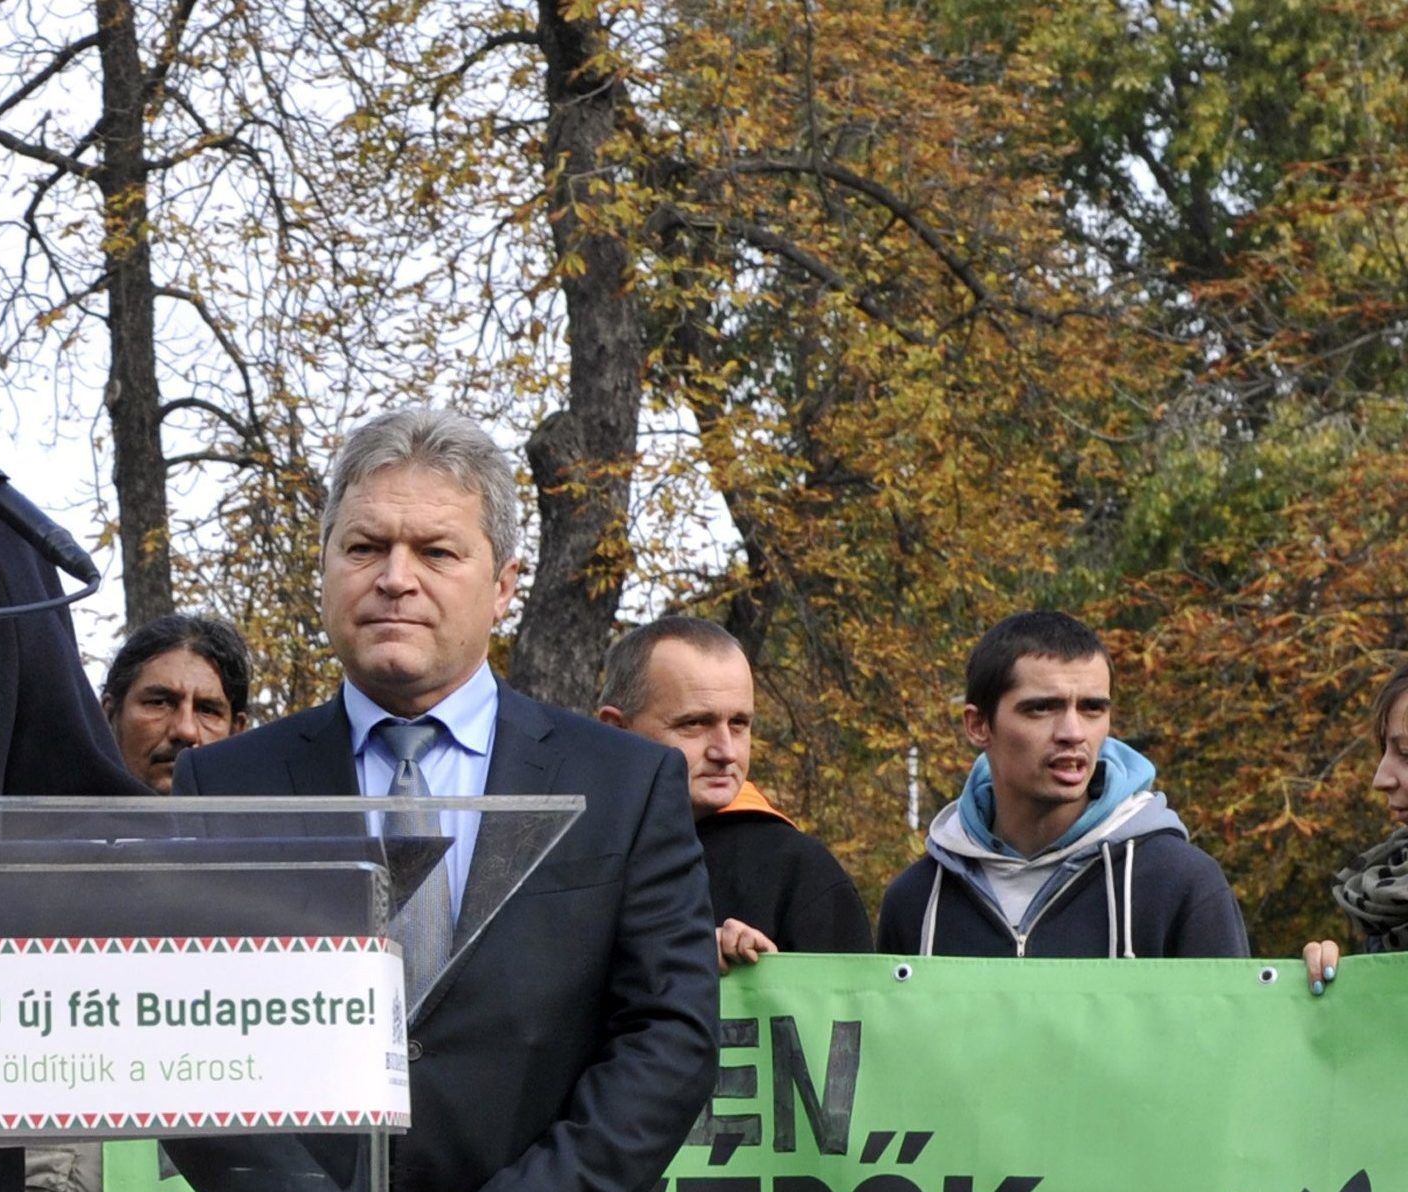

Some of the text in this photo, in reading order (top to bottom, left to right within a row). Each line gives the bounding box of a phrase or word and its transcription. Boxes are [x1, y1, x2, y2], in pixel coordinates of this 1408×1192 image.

[19, 989, 52, 1037] új
[68, 989, 120, 1027] fát
[137, 987, 375, 1036] Budapestre!
[129, 1060, 145, 1081] a
[159, 1053, 263, 1081] várost.
